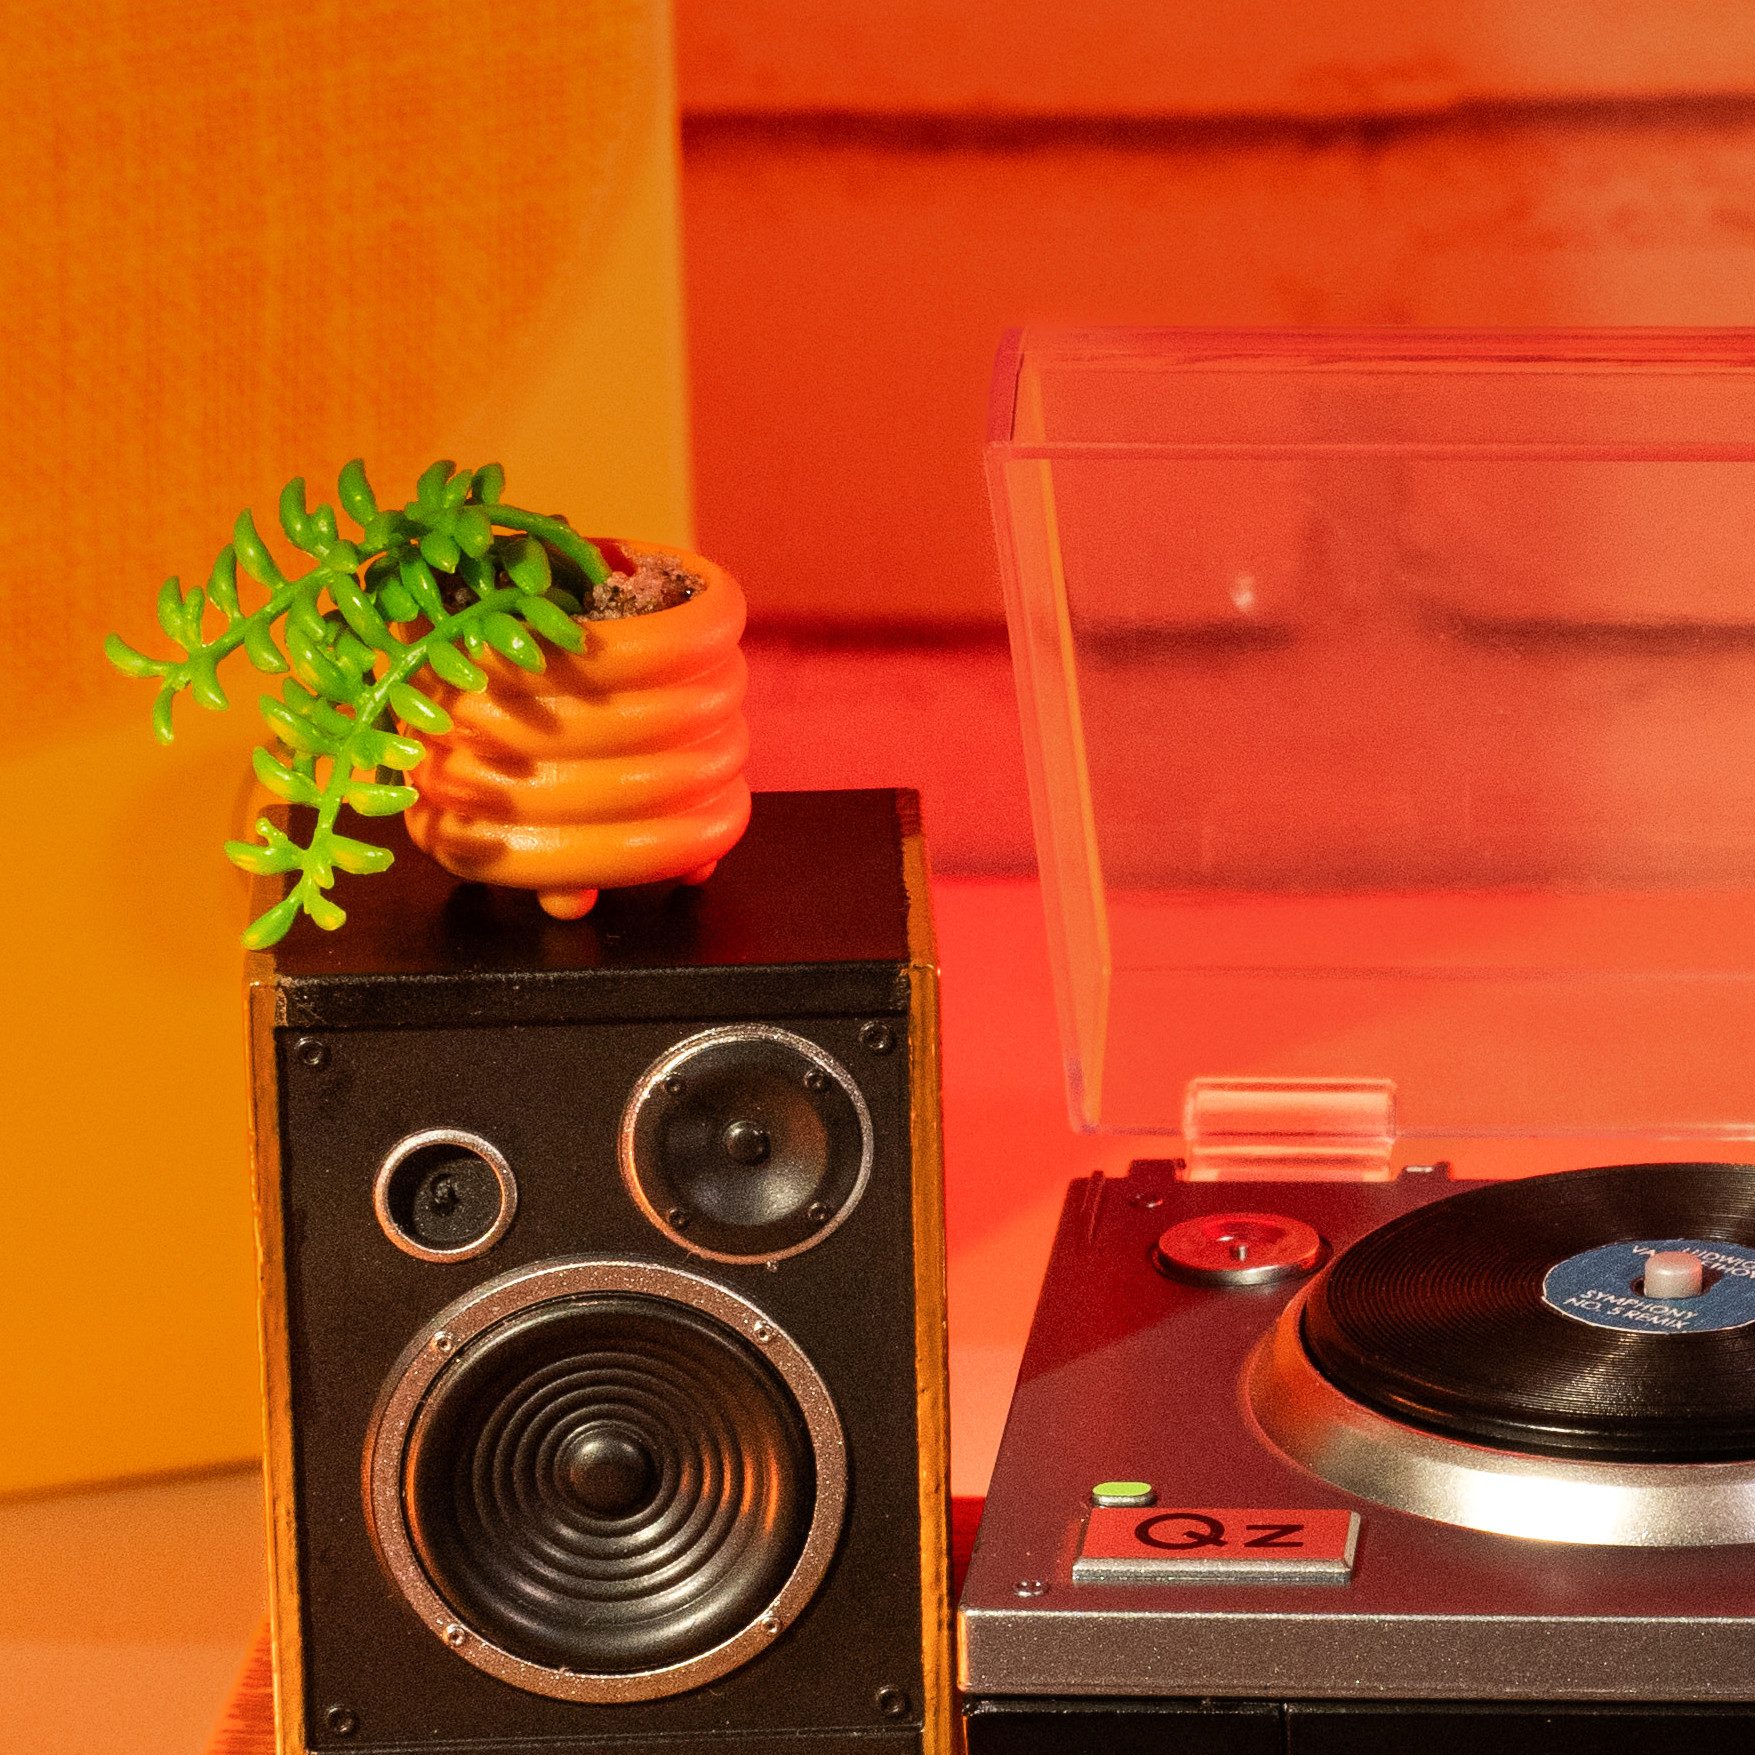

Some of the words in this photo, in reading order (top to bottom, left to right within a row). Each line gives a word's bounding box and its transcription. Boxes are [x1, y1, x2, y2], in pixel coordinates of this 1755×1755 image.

[1562, 1297, 1602, 1313] NO.
[1606, 1306, 1626, 1316] 5
[1623, 1309, 1691, 1330] REMIX
[1580, 1289, 1699, 1320] SYMPHONY
